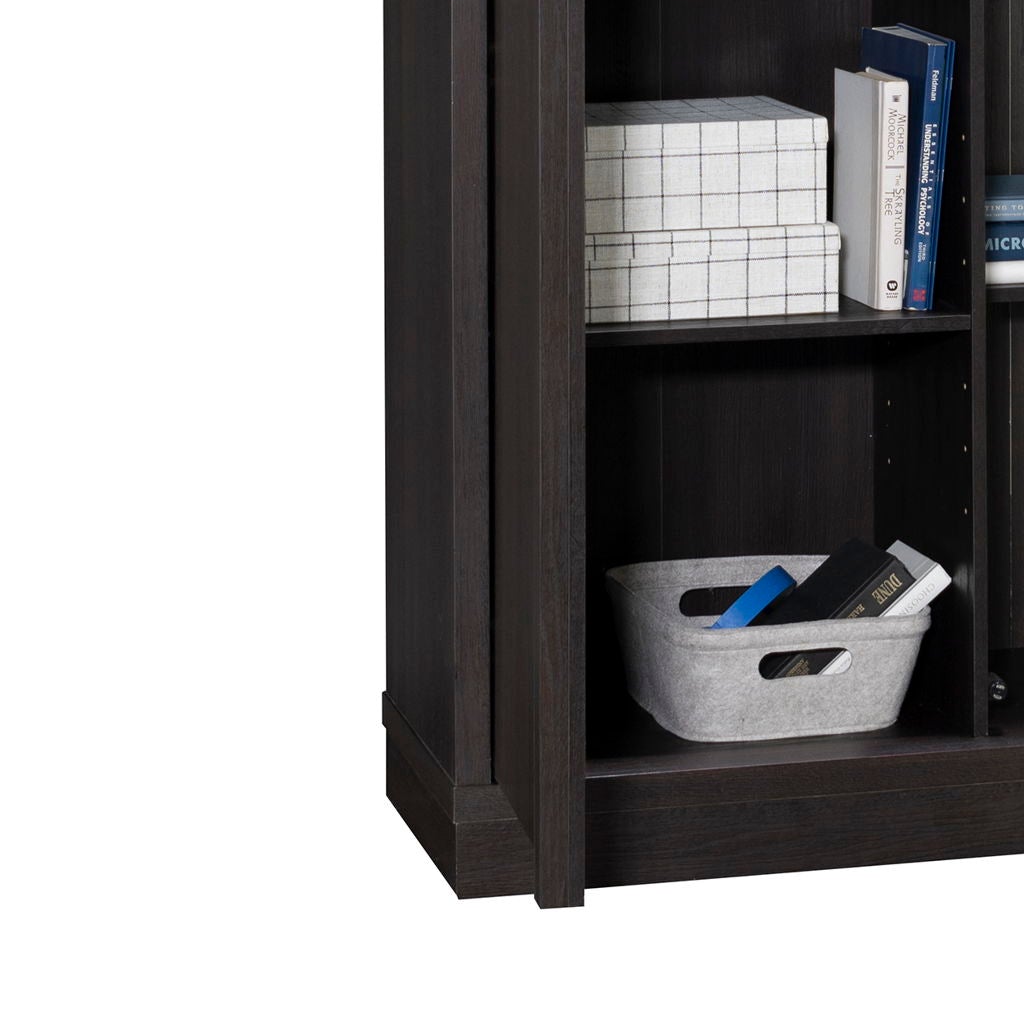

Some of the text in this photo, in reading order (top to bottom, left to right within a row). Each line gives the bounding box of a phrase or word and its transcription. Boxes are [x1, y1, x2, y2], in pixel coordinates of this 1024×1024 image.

[930, 69, 939, 102] Feldman
[887, 107, 898, 161] MOORCOCK
[884, 190, 895, 217] TREE
[918, 124, 932, 236] UNDERSTANDING PSYCHOLOGY
[924, 124, 938, 236] ESSENTIALS OF
[894, 187, 905, 246] SKRAYLING
[871, 572, 903, 605] DUNE
